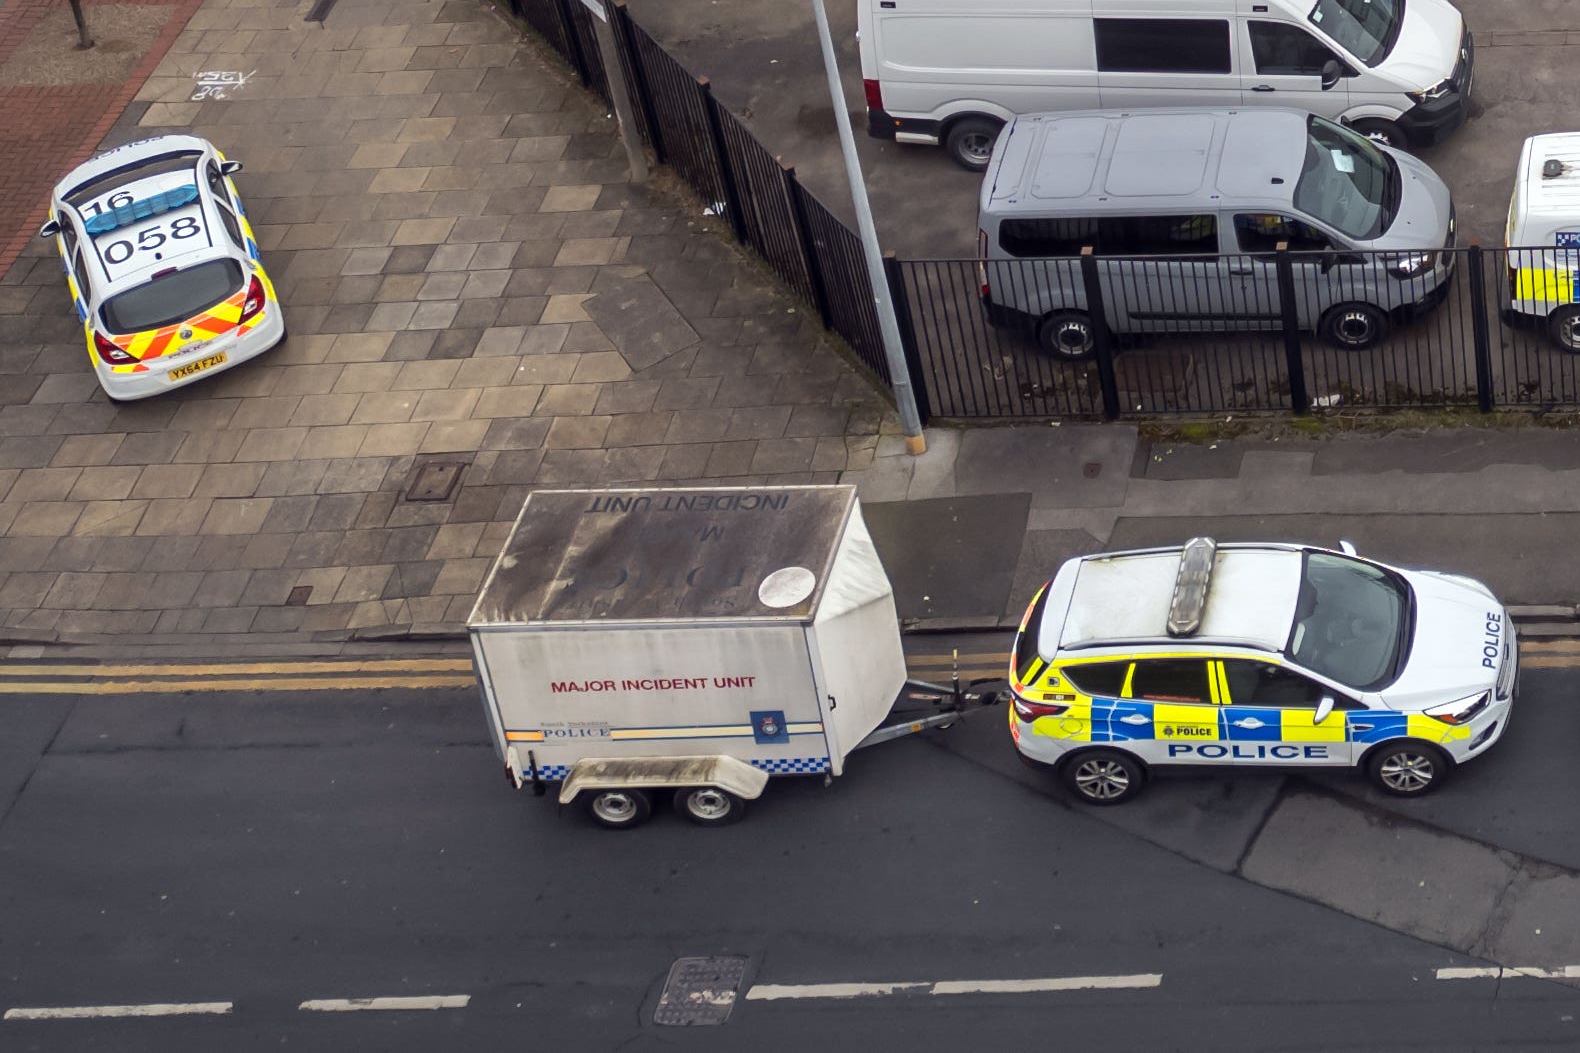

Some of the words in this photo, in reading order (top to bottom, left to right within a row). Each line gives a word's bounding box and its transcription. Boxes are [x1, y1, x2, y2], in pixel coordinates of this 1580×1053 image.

[84, 191, 134, 215] 16
[104, 216, 201, 264] 058
[584, 496, 651, 514] UNIT
[658, 494, 790, 512] INCIDENT
[1482, 612, 1501, 669] POLICE
[551, 680, 617, 693] MAJOR
[621, 678, 708, 691] INCIDENT
[714, 676, 756, 689] UNIT
[543, 728, 611, 738] POLICE
[1176, 728, 1212, 736] POLICE
[1168, 743, 1329, 759] POLICE
